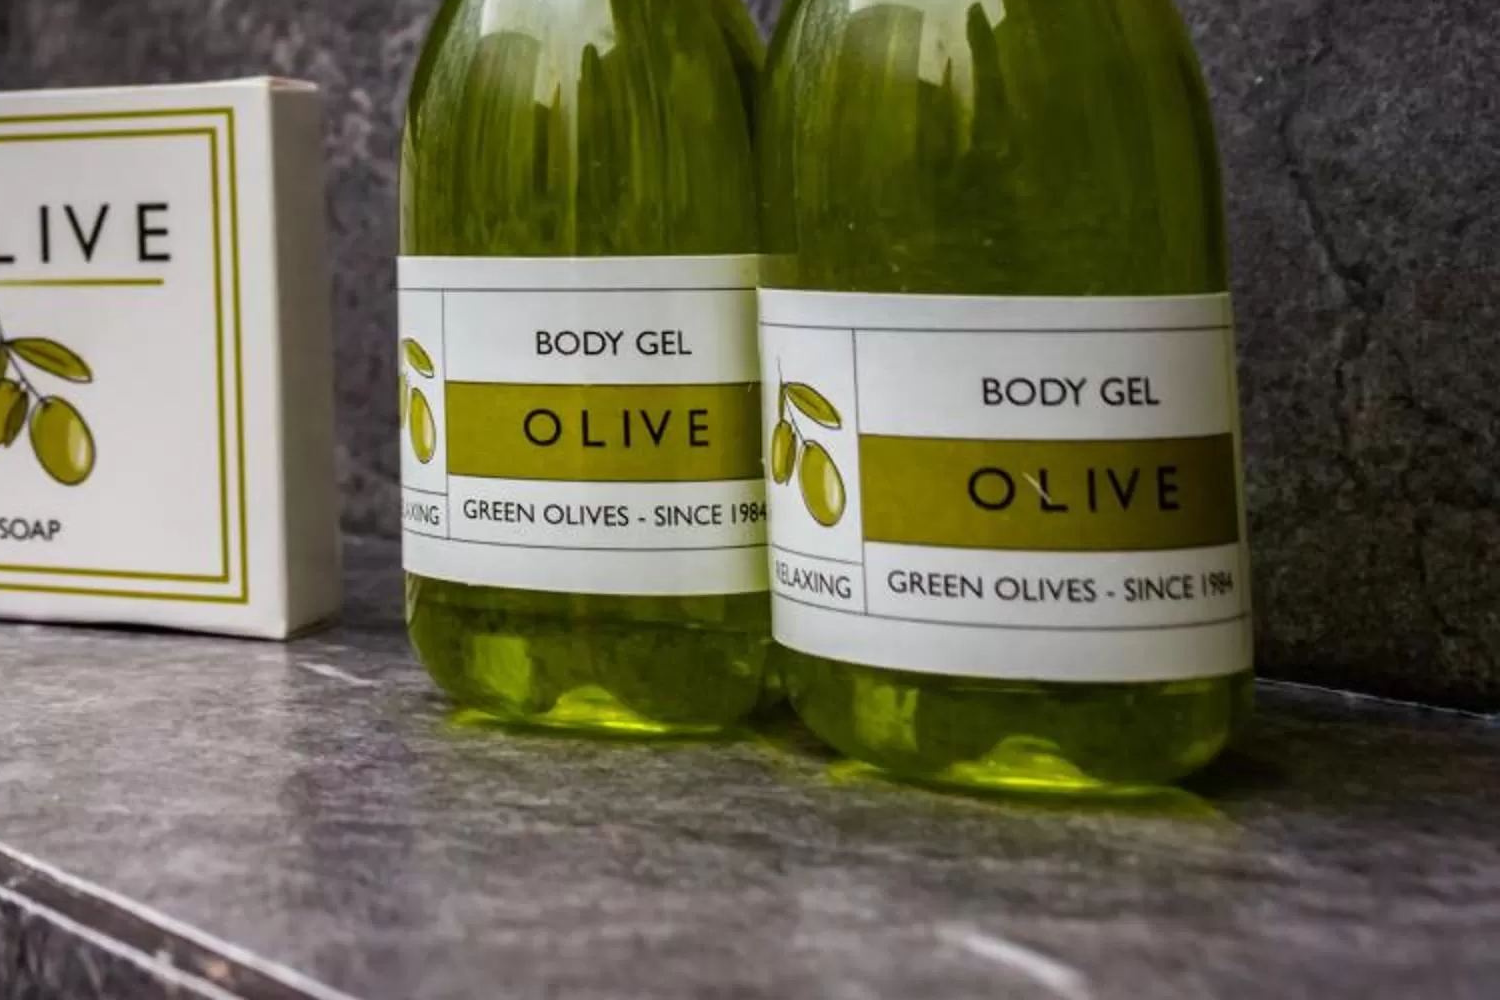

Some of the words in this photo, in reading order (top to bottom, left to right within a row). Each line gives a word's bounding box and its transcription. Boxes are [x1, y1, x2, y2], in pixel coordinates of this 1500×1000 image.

[535, 331, 624, 357] BODY
[636, 330, 692, 356] GEL
[982, 377, 1087, 407] BODY
[1100, 377, 1160, 406] GEL
[523, 408, 710, 448] OLIVE
[968, 465, 1182, 514] OLIVE
[463, 499, 535, 524] GREEN
[543, 503, 630, 527] OLIVES
[654, 504, 723, 527] SINCE
[731, 501, 767, 525] 1984
[888, 569, 984, 601] GREEN
[995, 574, 1097, 602] OLIVES
[1123, 573, 1195, 603] SINCE
